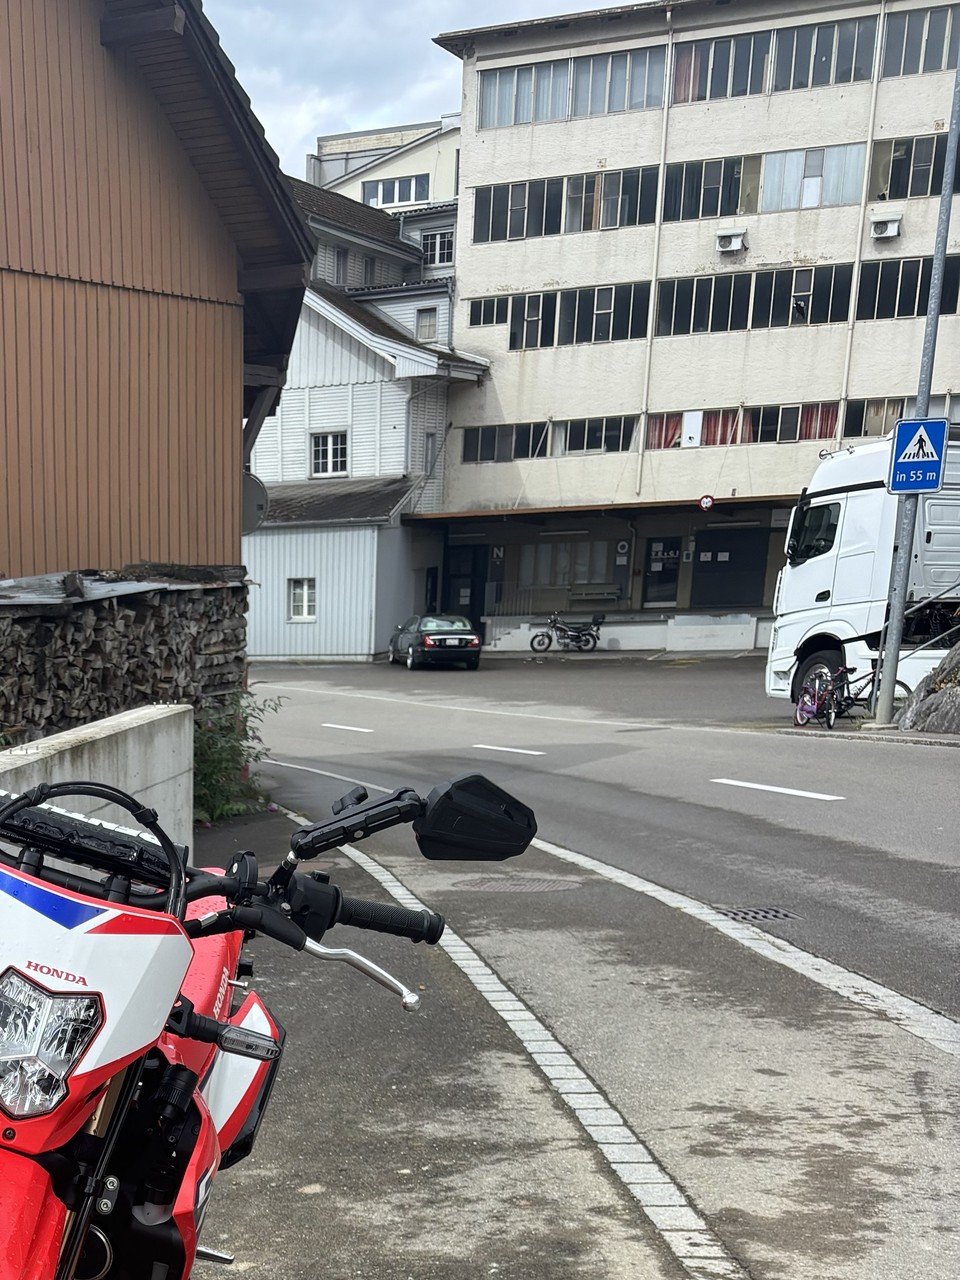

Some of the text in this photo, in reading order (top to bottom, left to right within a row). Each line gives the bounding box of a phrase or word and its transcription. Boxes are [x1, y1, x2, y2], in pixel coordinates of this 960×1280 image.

[896, 470, 936, 482] in 55 m
[493, 546, 504, 558] N
[25, 960, 88, 987] HONDA
[213, 966, 229, 1020] HONDA
